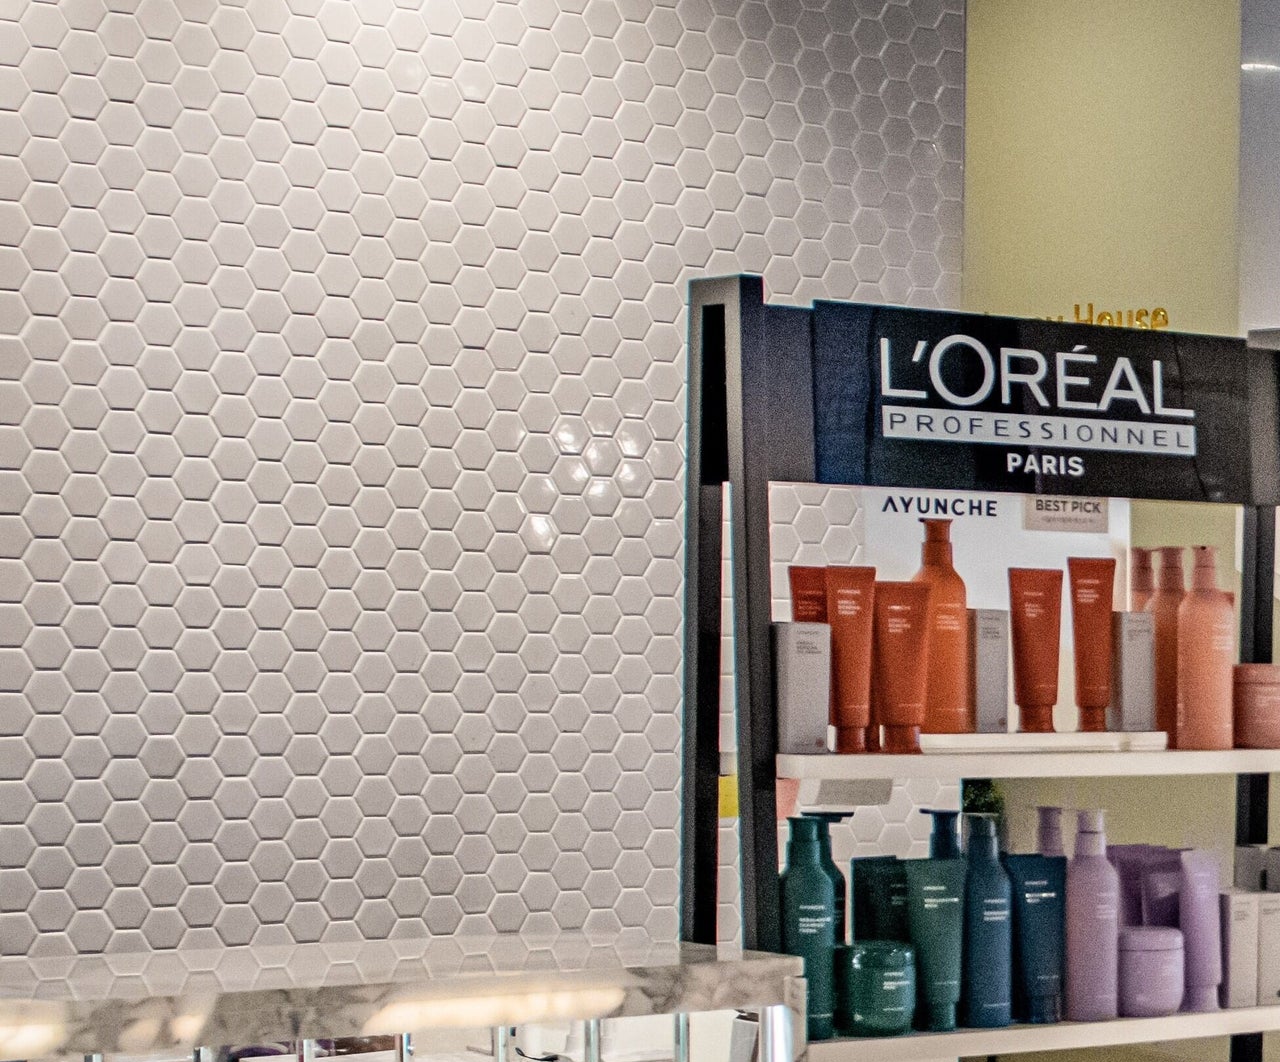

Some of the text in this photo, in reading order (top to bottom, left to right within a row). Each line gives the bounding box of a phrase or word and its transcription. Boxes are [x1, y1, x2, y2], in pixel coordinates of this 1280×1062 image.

[880, 334, 1195, 418] L'ORÉAL
[889, 412, 1189, 449] PROFESSIONNEL
[1006, 452, 1085, 476] PARIS
[882, 496, 998, 517] AYUNCHE
[1035, 499, 1102, 514] BEST PICK
